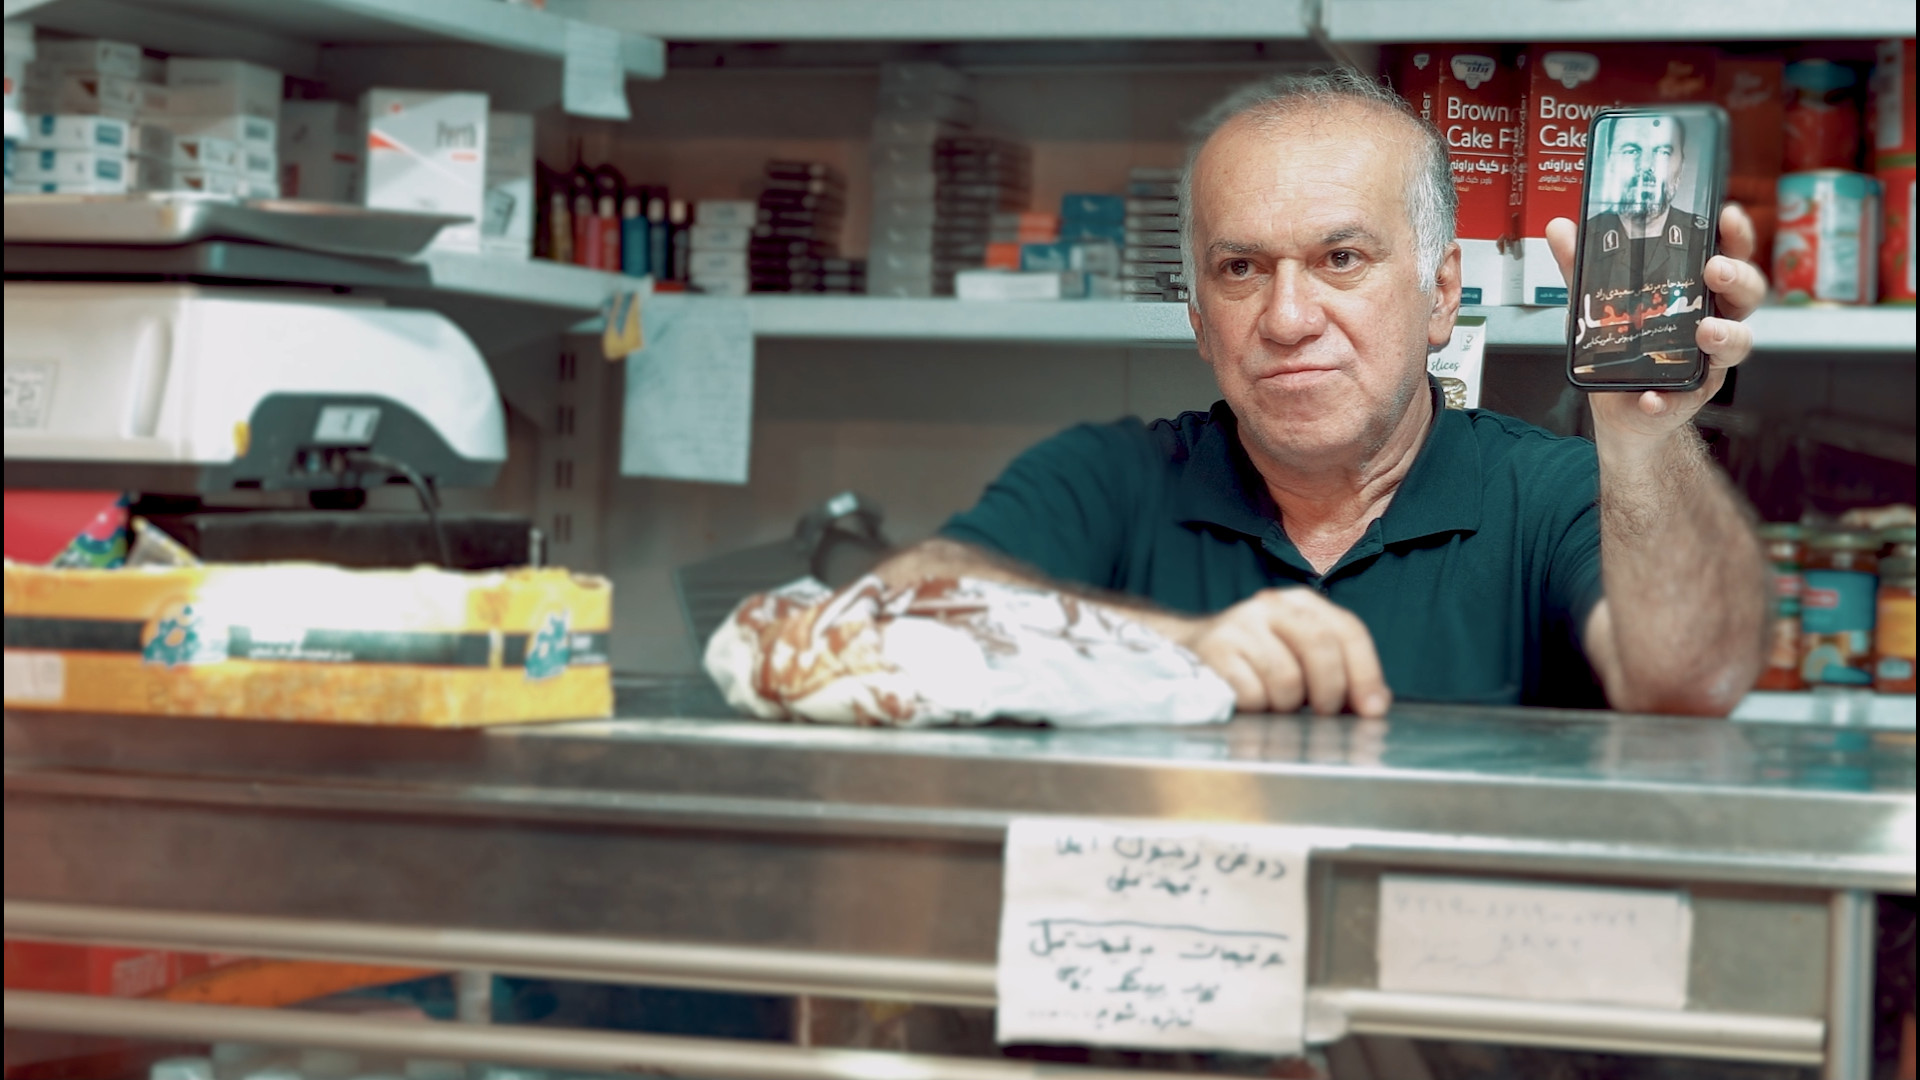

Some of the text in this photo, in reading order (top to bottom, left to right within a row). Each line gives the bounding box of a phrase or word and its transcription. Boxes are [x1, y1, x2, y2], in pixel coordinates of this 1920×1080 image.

[1447, 96, 1509, 122] Brown
[1447, 125, 1493, 149] Cake
[1475, 159, 1499, 174] کیک
[1538, 159, 1573, 173] براونی
[1676, 279, 1695, 289] شهید
[1595, 288, 1606, 301] راد
[1606, 288, 1634, 300] سعیدی
[1431, 358, 1459, 371] slices
